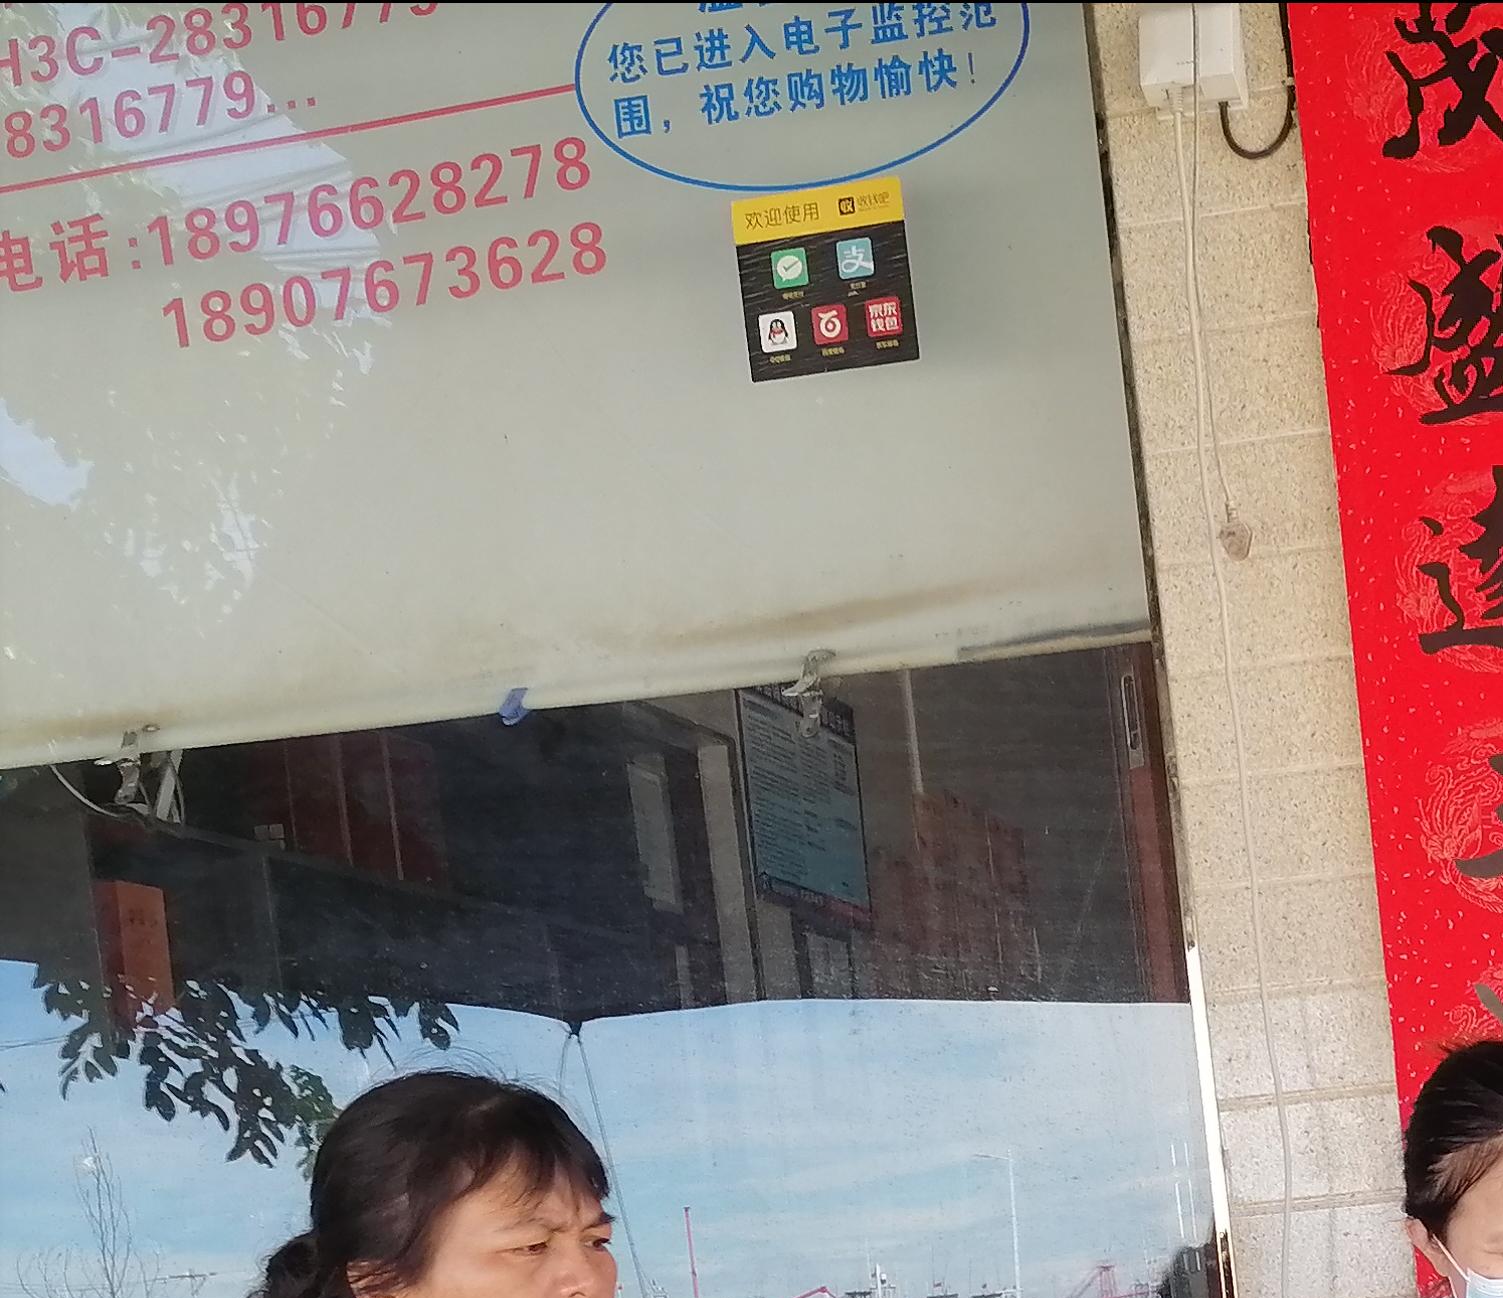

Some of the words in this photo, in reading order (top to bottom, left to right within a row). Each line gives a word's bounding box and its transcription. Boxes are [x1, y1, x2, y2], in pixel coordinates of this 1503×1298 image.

[745, 202, 820, 230] 欢迎使用
[163, 221, 607, 349] 18907673628
